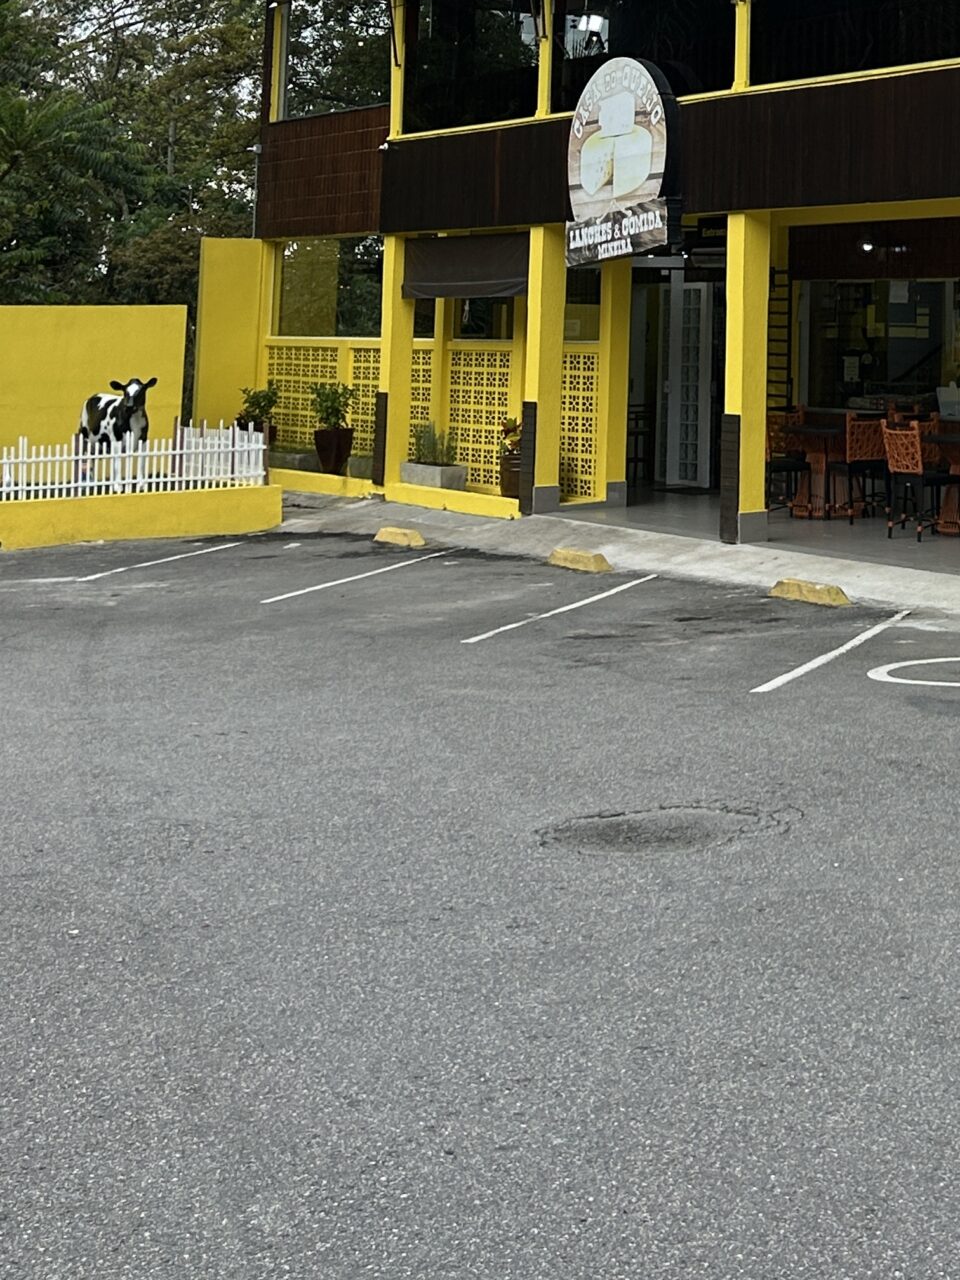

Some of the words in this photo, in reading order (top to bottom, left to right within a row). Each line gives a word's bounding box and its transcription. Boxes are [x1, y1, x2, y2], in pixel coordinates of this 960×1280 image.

[574, 81, 602, 140] CASA
[604, 70, 617, 93] DO
[622, 64, 662, 126] QUEIJO
[569, 222, 612, 250] LANCHES
[614, 224, 621, 239] &
[621, 210, 663, 237] COMIDA
[598, 238, 633, 260] MINEIRA
